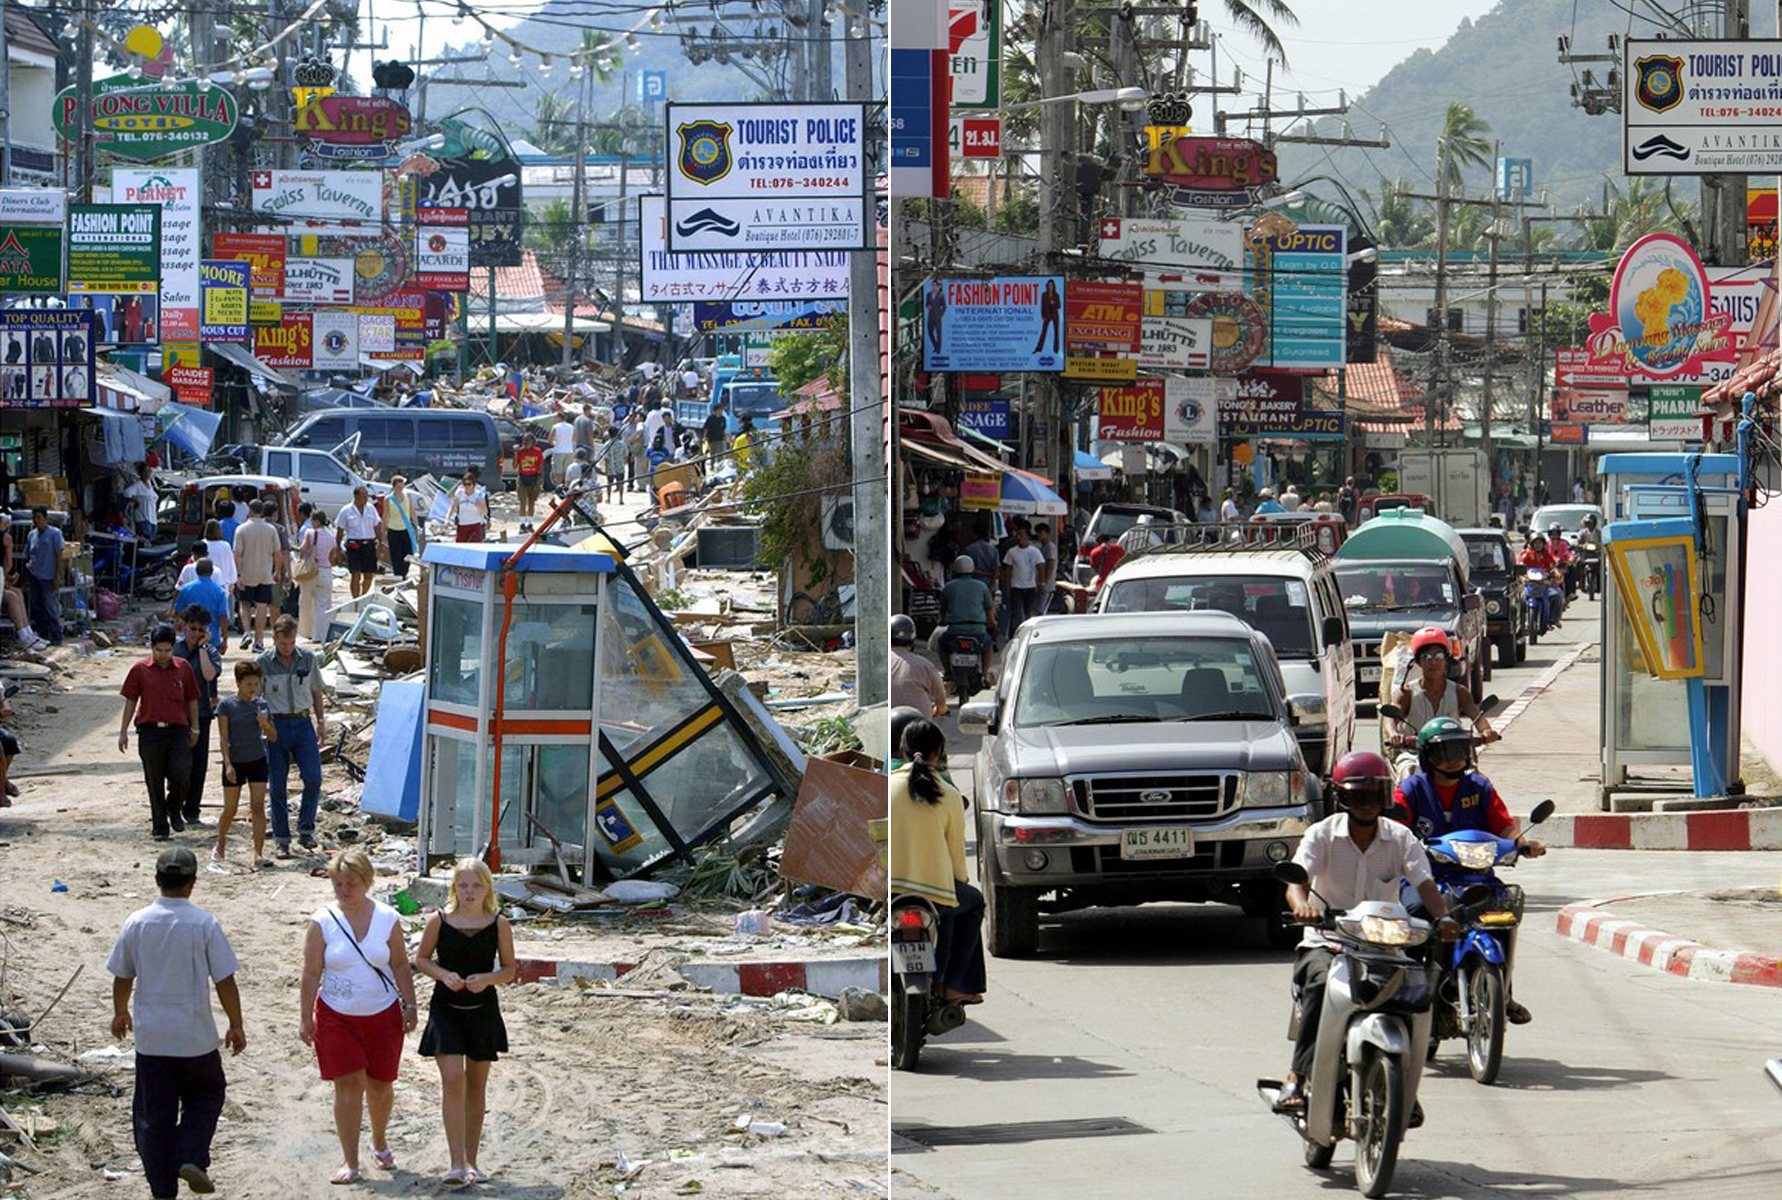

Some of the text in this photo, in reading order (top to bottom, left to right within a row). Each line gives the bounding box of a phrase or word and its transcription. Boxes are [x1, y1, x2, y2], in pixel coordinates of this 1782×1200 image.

[1688, 54, 1744, 77] TOURIST
[63, 93, 231, 124] PTONG VILLA
[291, 88, 411, 140] King's
[108, 118, 181, 127] HOTEL
[737, 118, 857, 145] TOURIST POLICE
[737, 147, 858, 171] ตำรวจท่องเที่ยว
[1144, 126, 1276, 185] King's
[1694, 154, 1726, 167] Boutique
[1726, 154, 1745, 166] Hotel
[750, 178, 849, 190] TEL:076-340244
[31, 196, 50, 205] Club
[126, 187, 187, 201] PLANET
[313, 183, 374, 217] Taverne
[71, 213, 153, 233] FASHION POINT
[753, 208, 853, 224] AVANTIKA
[162, 220, 191, 230] ssage
[745, 230, 778, 244] Boutique
[780, 229, 801, 243] Hotel
[1276, 233, 1336, 250] OPTIC
[162, 248, 191, 258] ssage
[1166, 234, 1235, 271] Taverne
[685, 250, 743, 271] MASSAGE
[815, 250, 849, 269] SALO
[1279, 260, 1303, 269] Exam
[18, 273, 58, 286] House
[162, 291, 192, 303] Salon
[947, 282, 1040, 306] FASHION POINT
[5, 312, 83, 324] TOP QUALITY
[161, 310, 183, 319] Daily
[955, 307, 1033, 315] INTERNATIONAL
[1081, 304, 1124, 321] ATM
[227, 325, 247, 335] CUT
[1068, 326, 1134, 338] EXCHANGE
[256, 321, 310, 356] King's
[1692, 337, 1729, 358] Salon
[1101, 387, 1161, 426] King's
[1260, 401, 1297, 410] BAKERY
[1567, 399, 1624, 414] Leather
[1101, 425, 1161, 439] Fashion
[1153, 830, 1188, 846] 4411
[905, 962, 924, 972] 60
